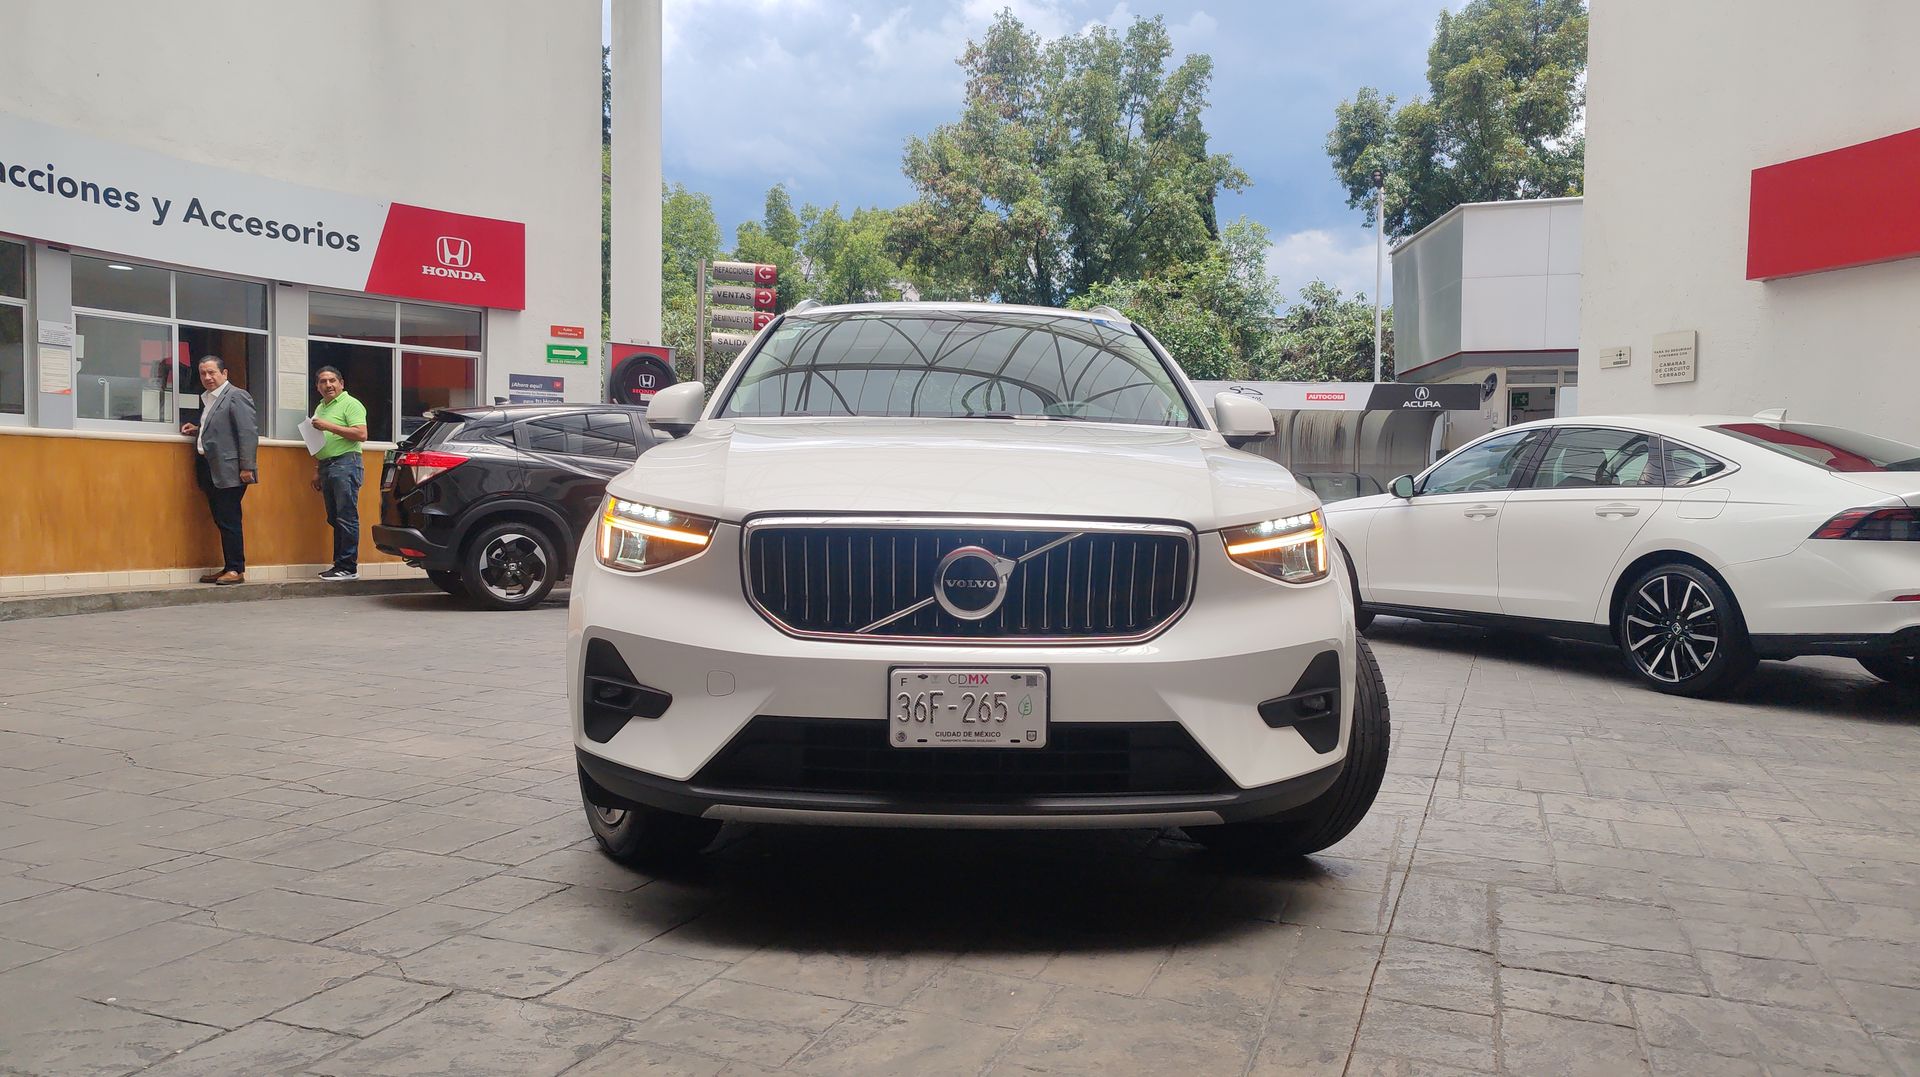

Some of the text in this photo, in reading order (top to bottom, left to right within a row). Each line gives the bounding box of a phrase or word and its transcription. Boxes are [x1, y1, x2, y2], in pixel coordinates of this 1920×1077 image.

[0, 161, 361, 252] cciones y Accesorios
[422, 265, 486, 282] HONDA
[714, 266, 754, 275] REFACCIONES
[717, 290, 752, 300] VENTAS
[713, 314, 753, 324] SEMINUEVOS
[717, 337, 748, 347] SALIDA
[1402, 400, 1442, 408] ACURA
[944, 579, 997, 589] VOLVO
[900, 677, 908, 686] F
[948, 673, 989, 685] CDMX
[897, 690, 1008, 724] 36F-265
[974, 730, 1001, 738] MÉXICO
